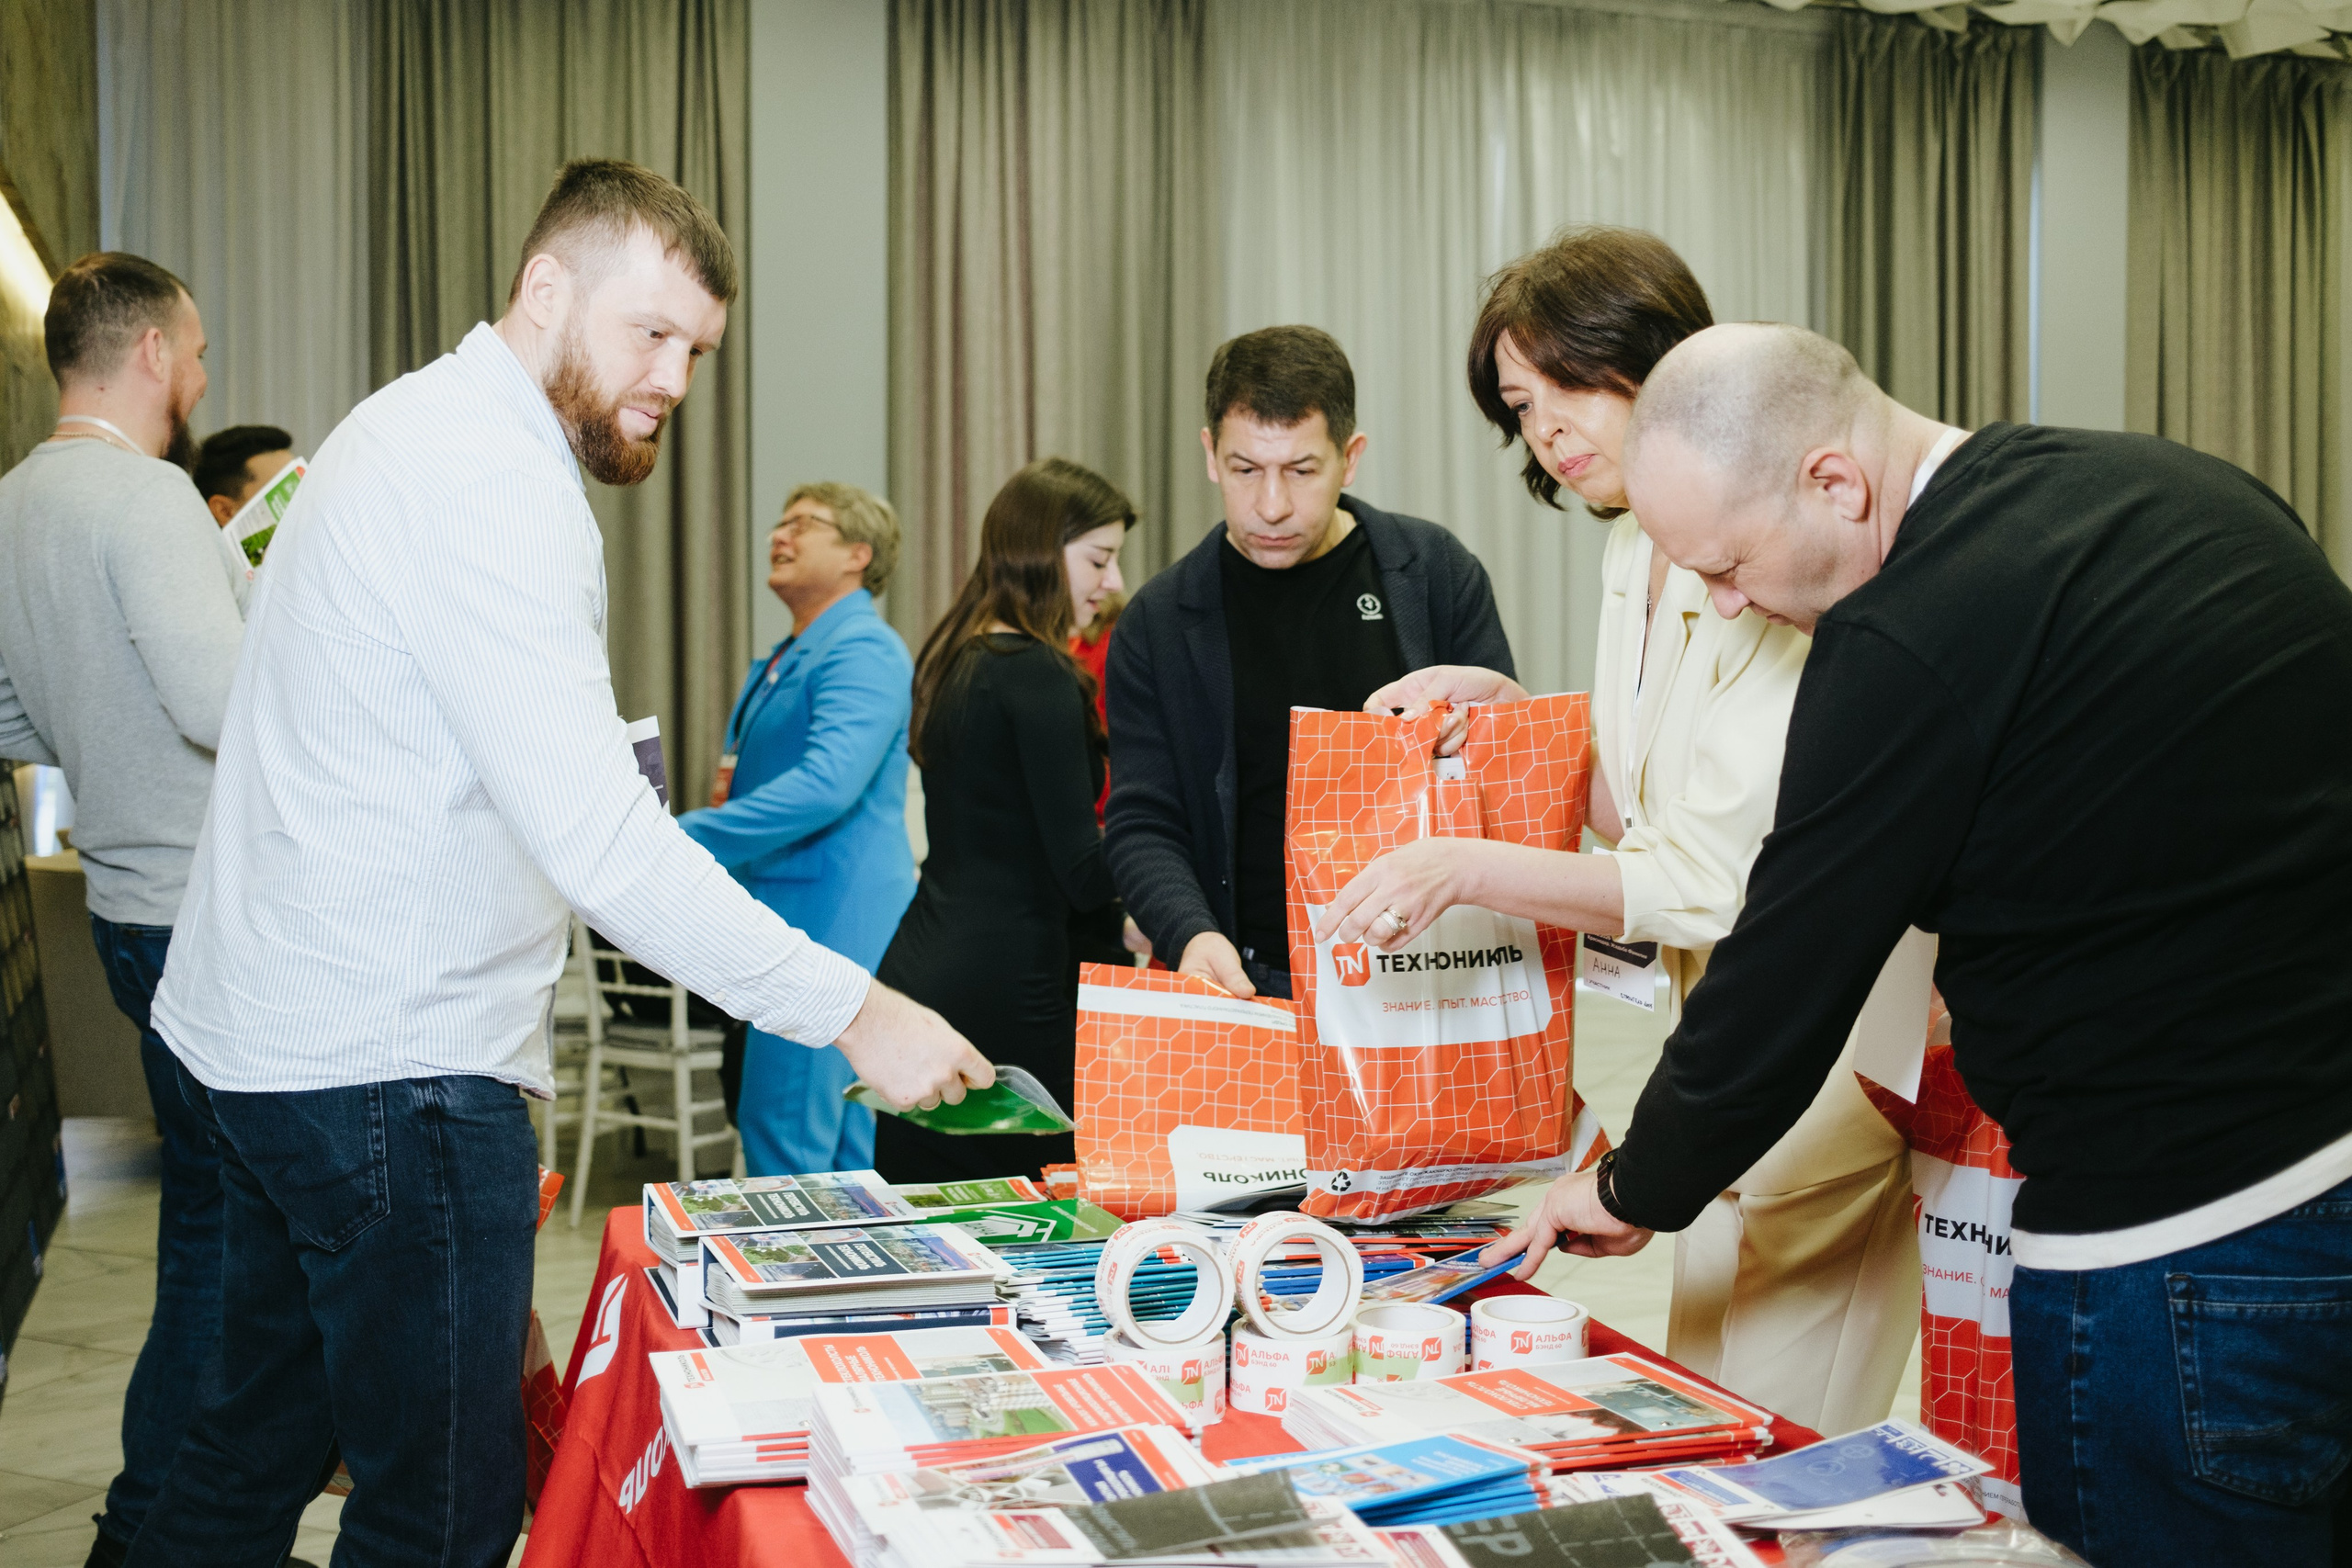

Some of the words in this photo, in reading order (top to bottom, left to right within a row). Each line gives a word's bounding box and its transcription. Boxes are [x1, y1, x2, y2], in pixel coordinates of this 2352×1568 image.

[1376, 944, 1523, 973] ТЕХНОНИКЛЬ
[1592, 957, 1621, 978] АННА
[1438, 998, 1467, 1010] ПЫТ.
[1535, 1332, 1572, 1343] АЛЬФА
[1250, 1349, 1290, 1361] АЛЬФА
[1386, 1349, 1419, 1359] АЛЬФ
